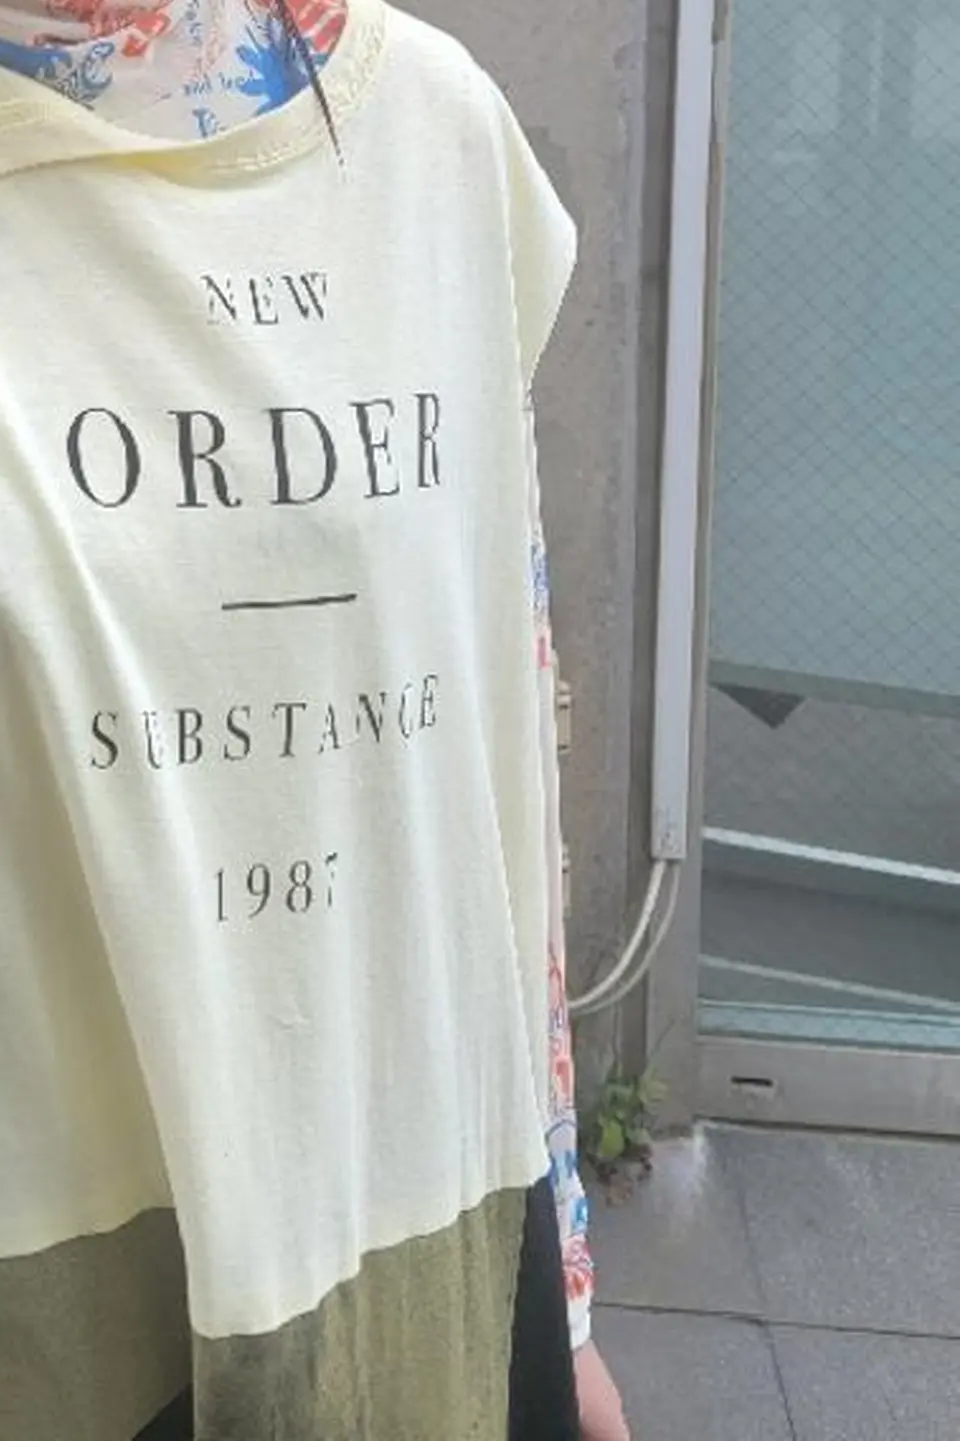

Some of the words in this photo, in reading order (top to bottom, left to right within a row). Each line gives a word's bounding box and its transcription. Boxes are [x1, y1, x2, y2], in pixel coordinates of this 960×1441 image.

[200, 271, 330, 326] NEW
[66, 392, 441, 509] ORDER
[90, 673, 440, 770] SUBSTANCE
